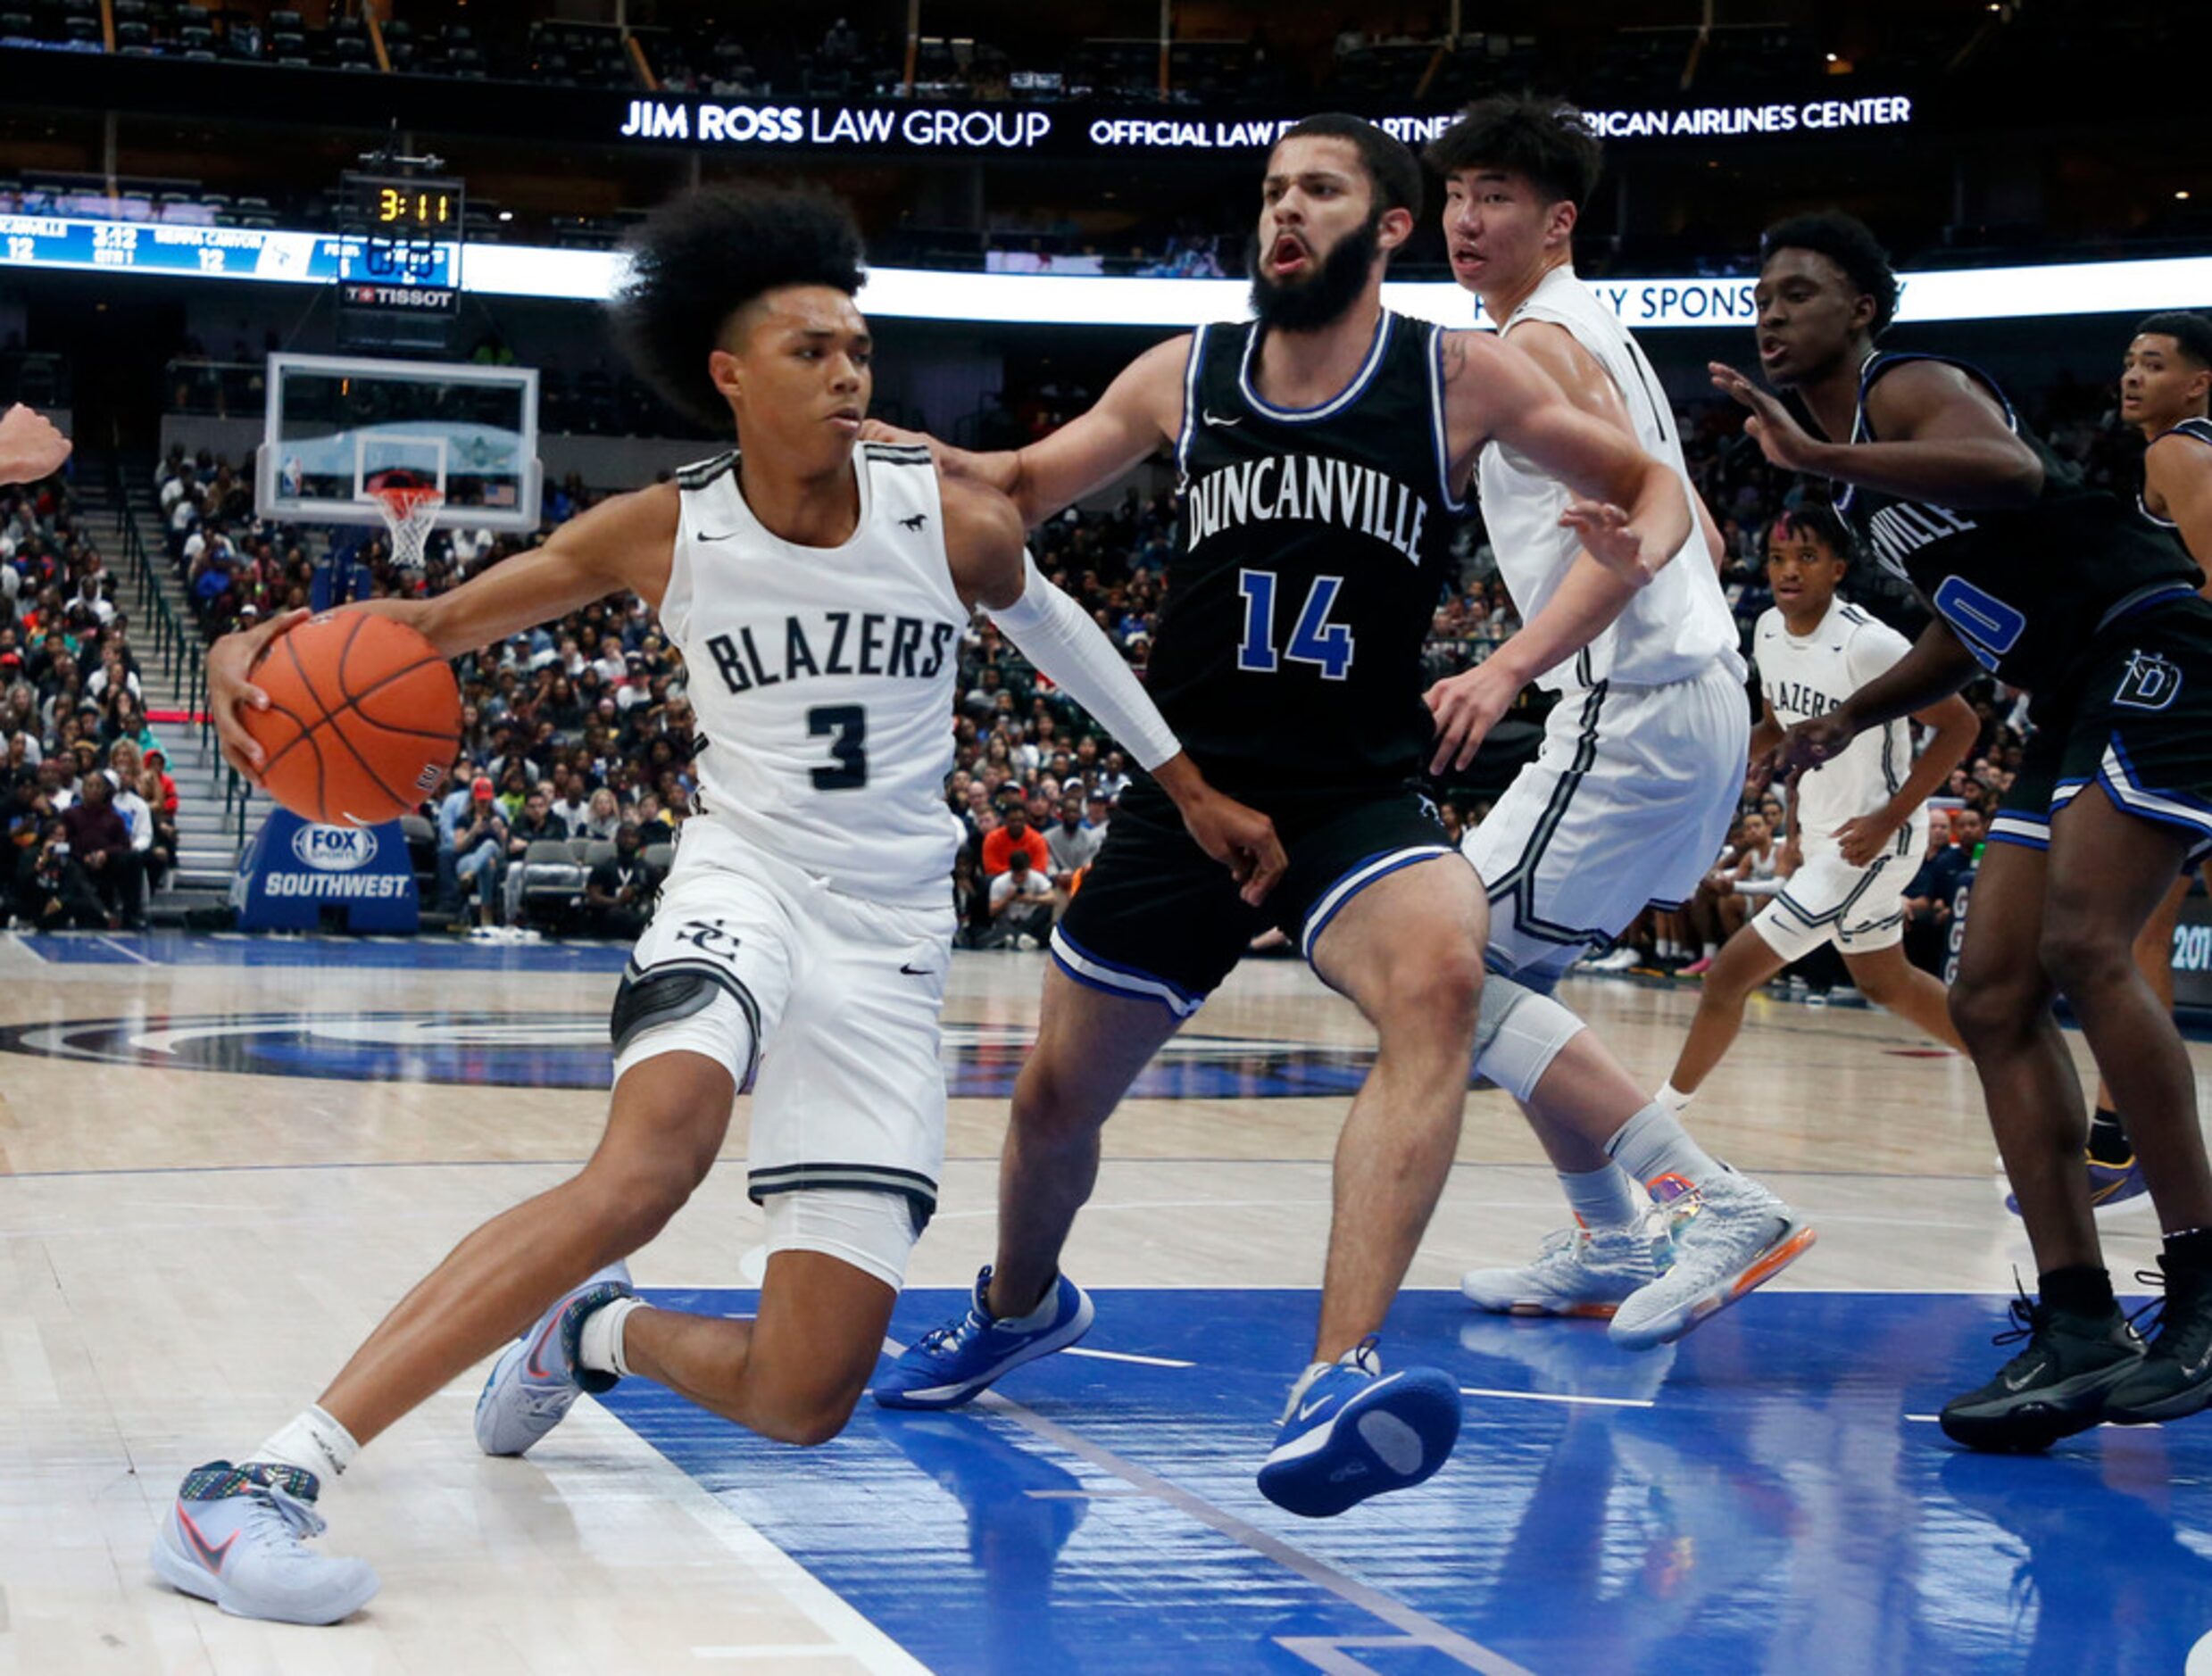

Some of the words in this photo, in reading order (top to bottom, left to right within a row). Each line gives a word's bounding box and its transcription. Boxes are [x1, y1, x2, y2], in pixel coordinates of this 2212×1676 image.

[621, 101, 688, 138] JIM
[699, 104, 803, 142] ROSS
[811, 108, 894, 144] LAW
[902, 110, 1051, 146] GROUP
[1089, 120, 1212, 147] OFFICIAL
[1216, 121, 1274, 147] LAW
[1671, 104, 1798, 136] AIRLINES
[1801, 96, 1911, 129] CENTER
[379, 188, 447, 223] 3:11
[7, 236, 35, 261] 12
[198, 248, 225, 271] 12
[375, 288, 453, 308] TISSOT
[1641, 286, 1754, 319] SPONS
[1187, 454, 1427, 567] DUNCANVILLE
[1237, 568, 1355, 681] 14
[706, 612, 954, 695] BLAZERS
[1767, 681, 1842, 718] LAZERS
[807, 702, 868, 791] 3
[312, 829, 357, 850] FOX
[265, 871, 410, 898] SOUTHWEST
[2170, 923, 2212, 971] 201
